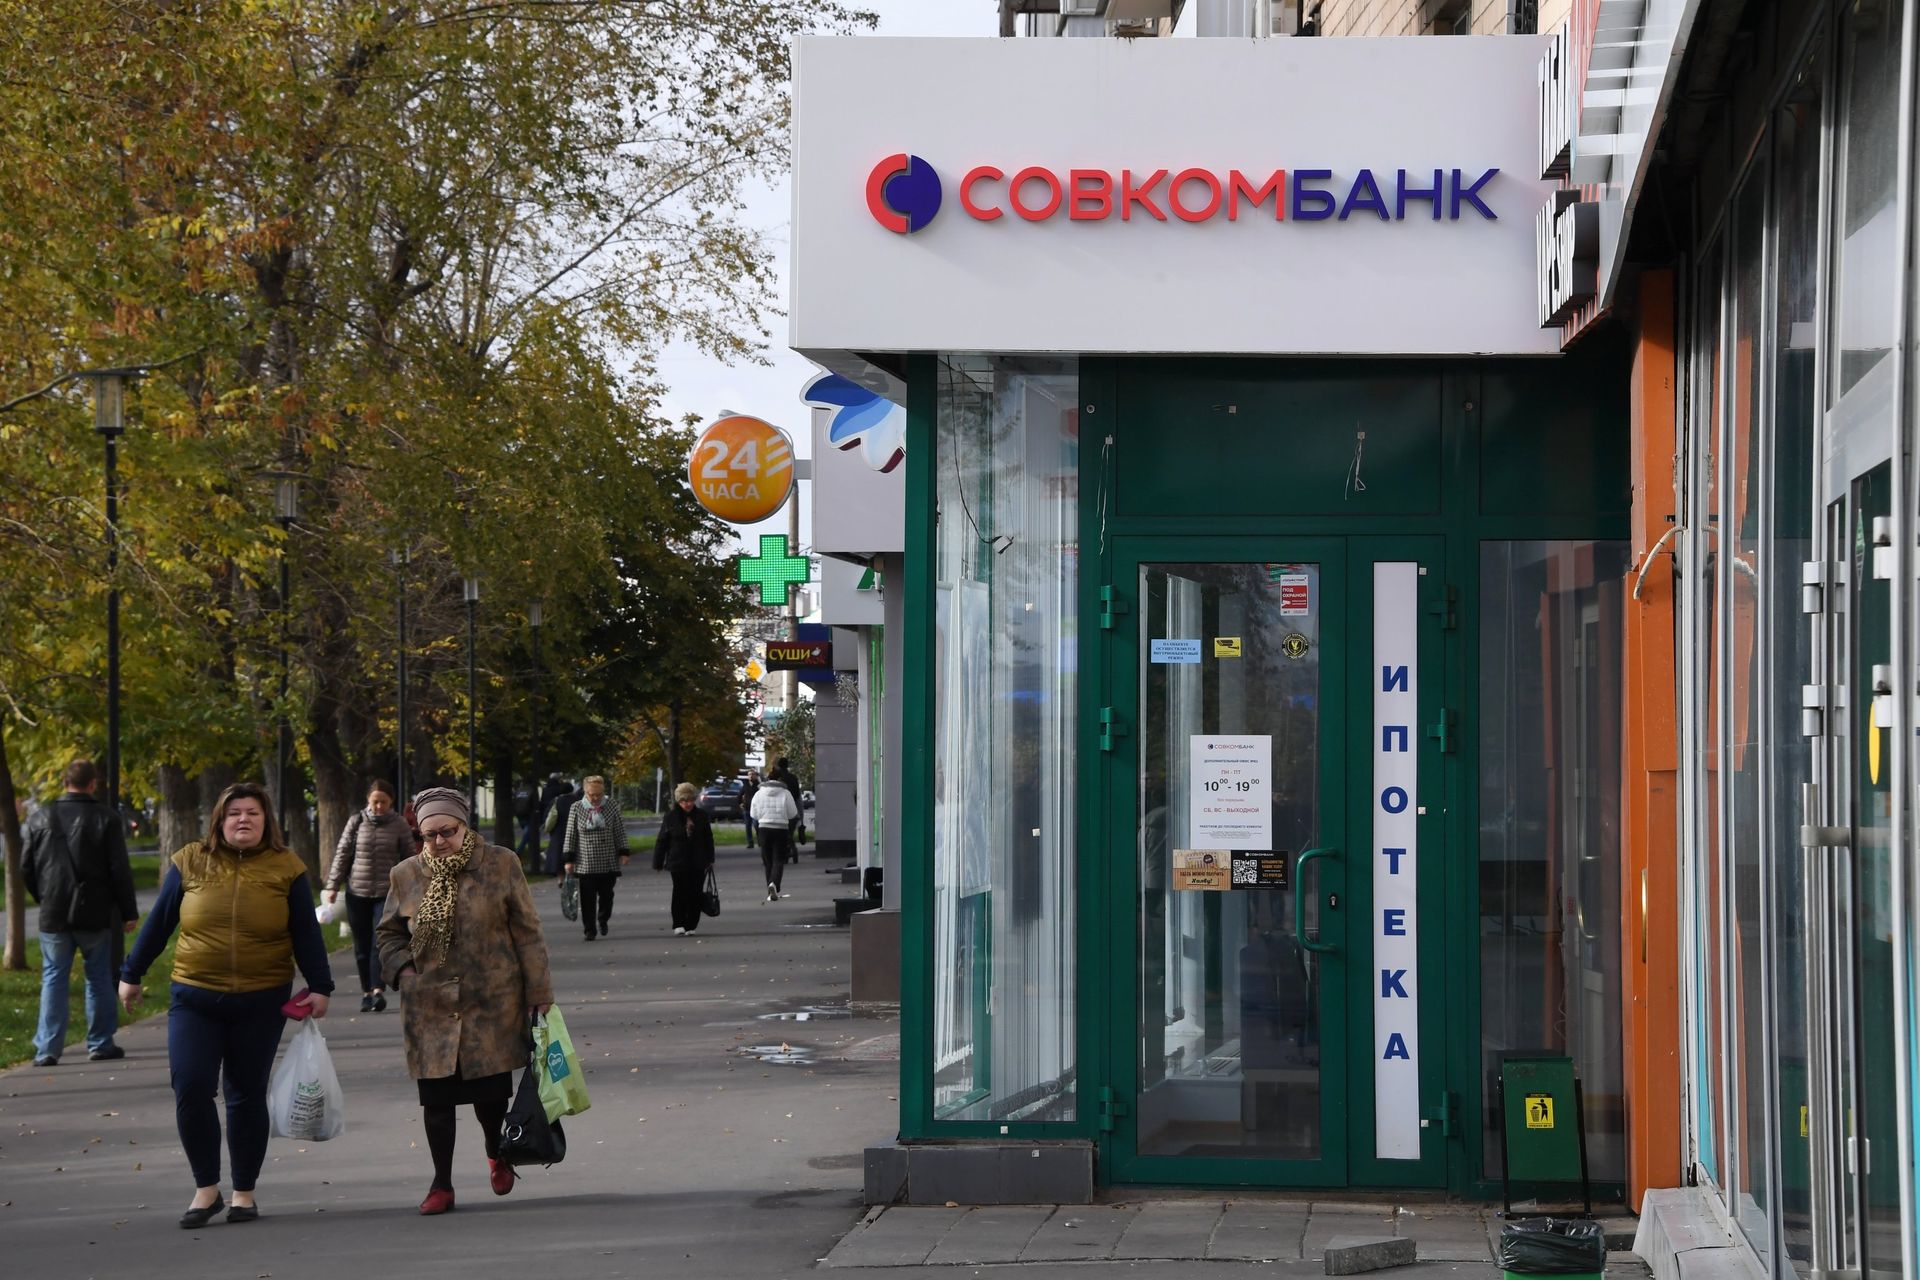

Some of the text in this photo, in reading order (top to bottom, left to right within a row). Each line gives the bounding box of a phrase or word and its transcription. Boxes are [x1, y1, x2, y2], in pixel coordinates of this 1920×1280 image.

[959, 165, 1500, 222] СОВКОМБАНК
[702, 439, 760, 478] 24
[701, 483, 760, 499] ЧАСА
[769, 648, 811, 660] СУШИ
[1380, 665, 1410, 1060] ИПОТЕКА
